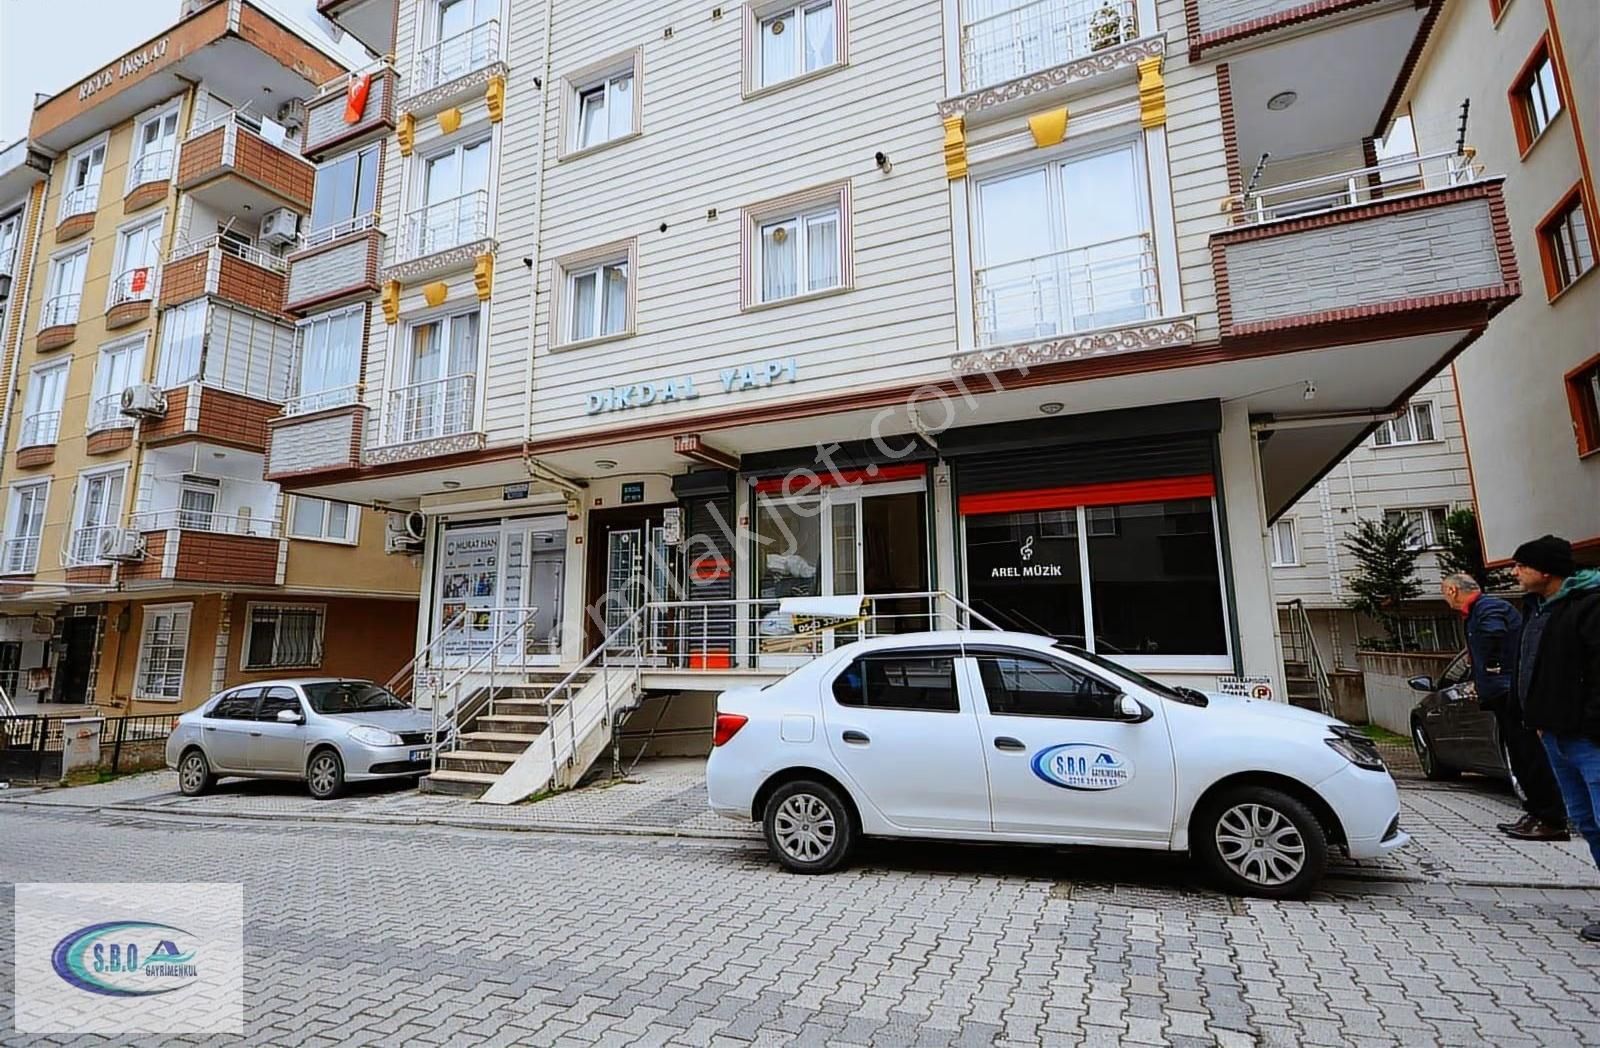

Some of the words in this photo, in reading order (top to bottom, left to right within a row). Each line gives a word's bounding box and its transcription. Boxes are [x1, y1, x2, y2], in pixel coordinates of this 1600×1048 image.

[584, 376, 700, 416] DİKDAL
[719, 357, 799, 394] YAPI
[991, 567, 1021, 577] AREL
[1022, 564, 1063, 577] MÜZİK
